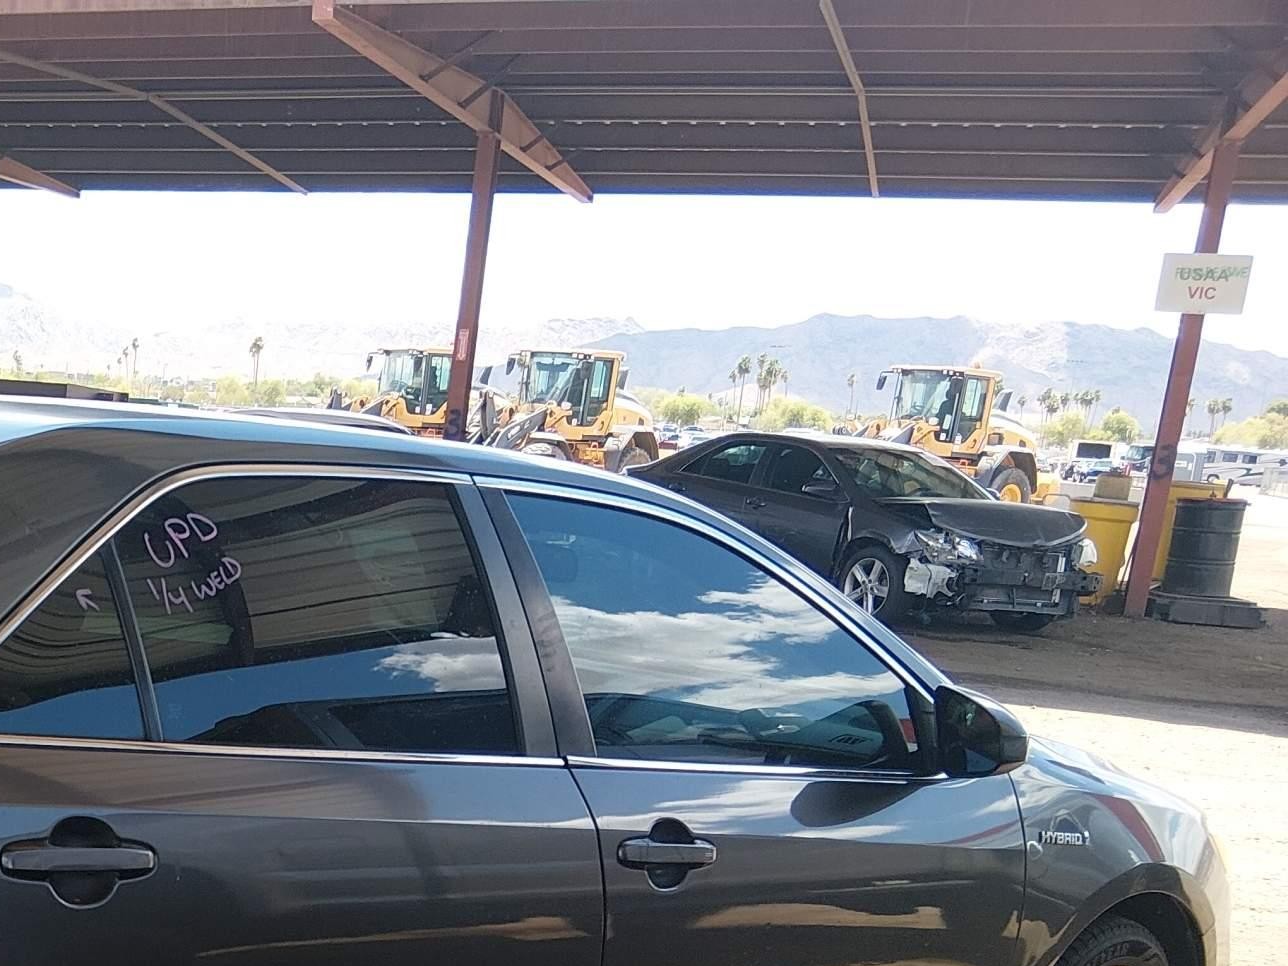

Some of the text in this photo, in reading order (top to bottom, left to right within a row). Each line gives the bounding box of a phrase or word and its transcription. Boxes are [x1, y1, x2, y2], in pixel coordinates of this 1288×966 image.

[1179, 267, 1230, 282] USAA
[1187, 286, 1217, 300] VIC
[144, 512, 218, 568] UPD
[146, 556, 242, 615] 1/4 WELD
[1041, 830, 1083, 846] HYBRID
